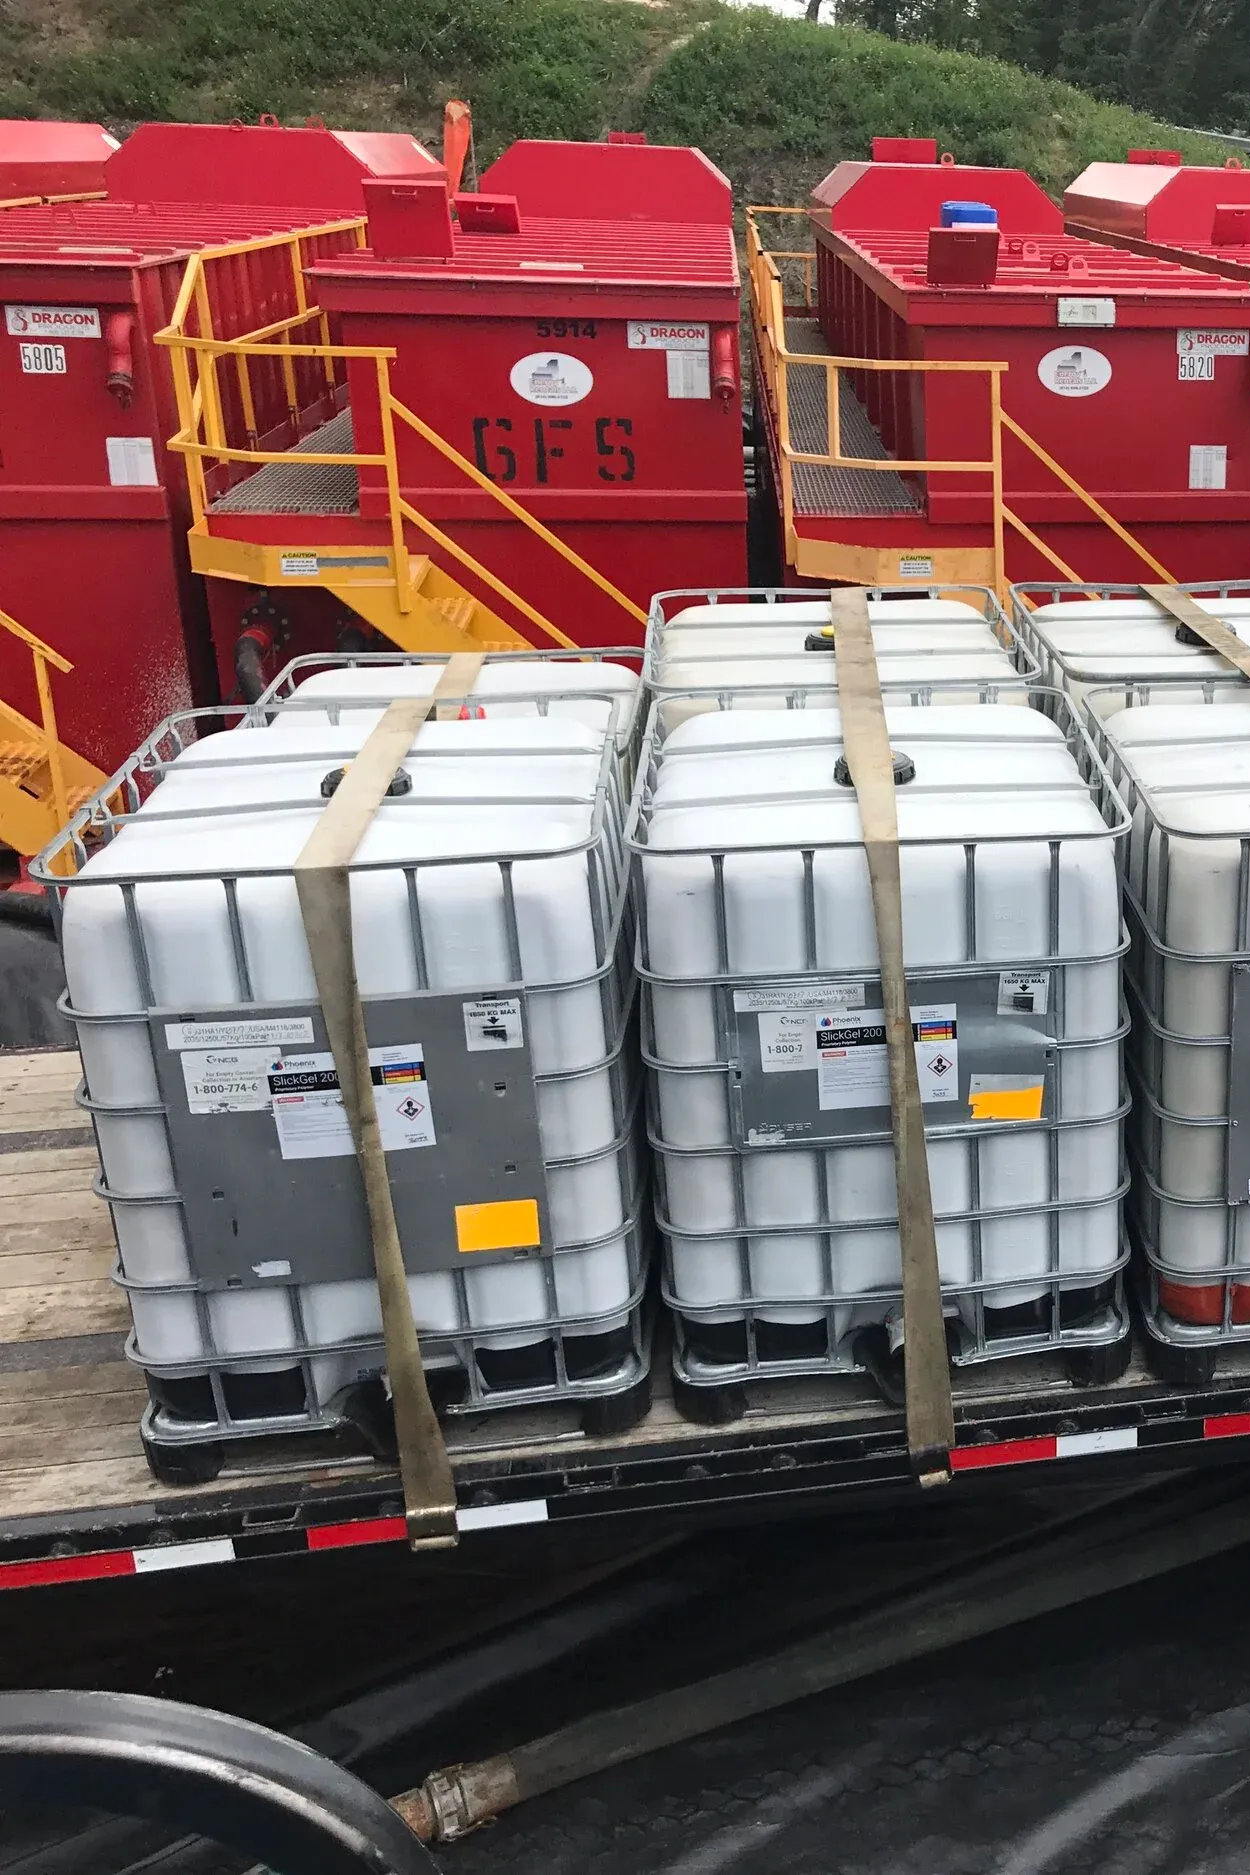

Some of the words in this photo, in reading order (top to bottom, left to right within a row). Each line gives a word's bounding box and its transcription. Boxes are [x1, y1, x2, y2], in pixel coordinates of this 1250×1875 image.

[31, 312, 95, 325] DRAGON
[537, 320, 597, 339] 5914
[650, 327, 705, 339] DRAGON
[1197, 334, 1246, 345] DRAGON
[22, 346, 64, 371] 5805
[1180, 356, 1213, 378] 5820
[832, 1016, 862, 1024] Phoenix
[820, 1029, 861, 1042] SlickGel
[863, 1028, 883, 1038] 200
[284, 1060, 316, 1068] Phoenix
[273, 1073, 318, 1087] SlickGel
